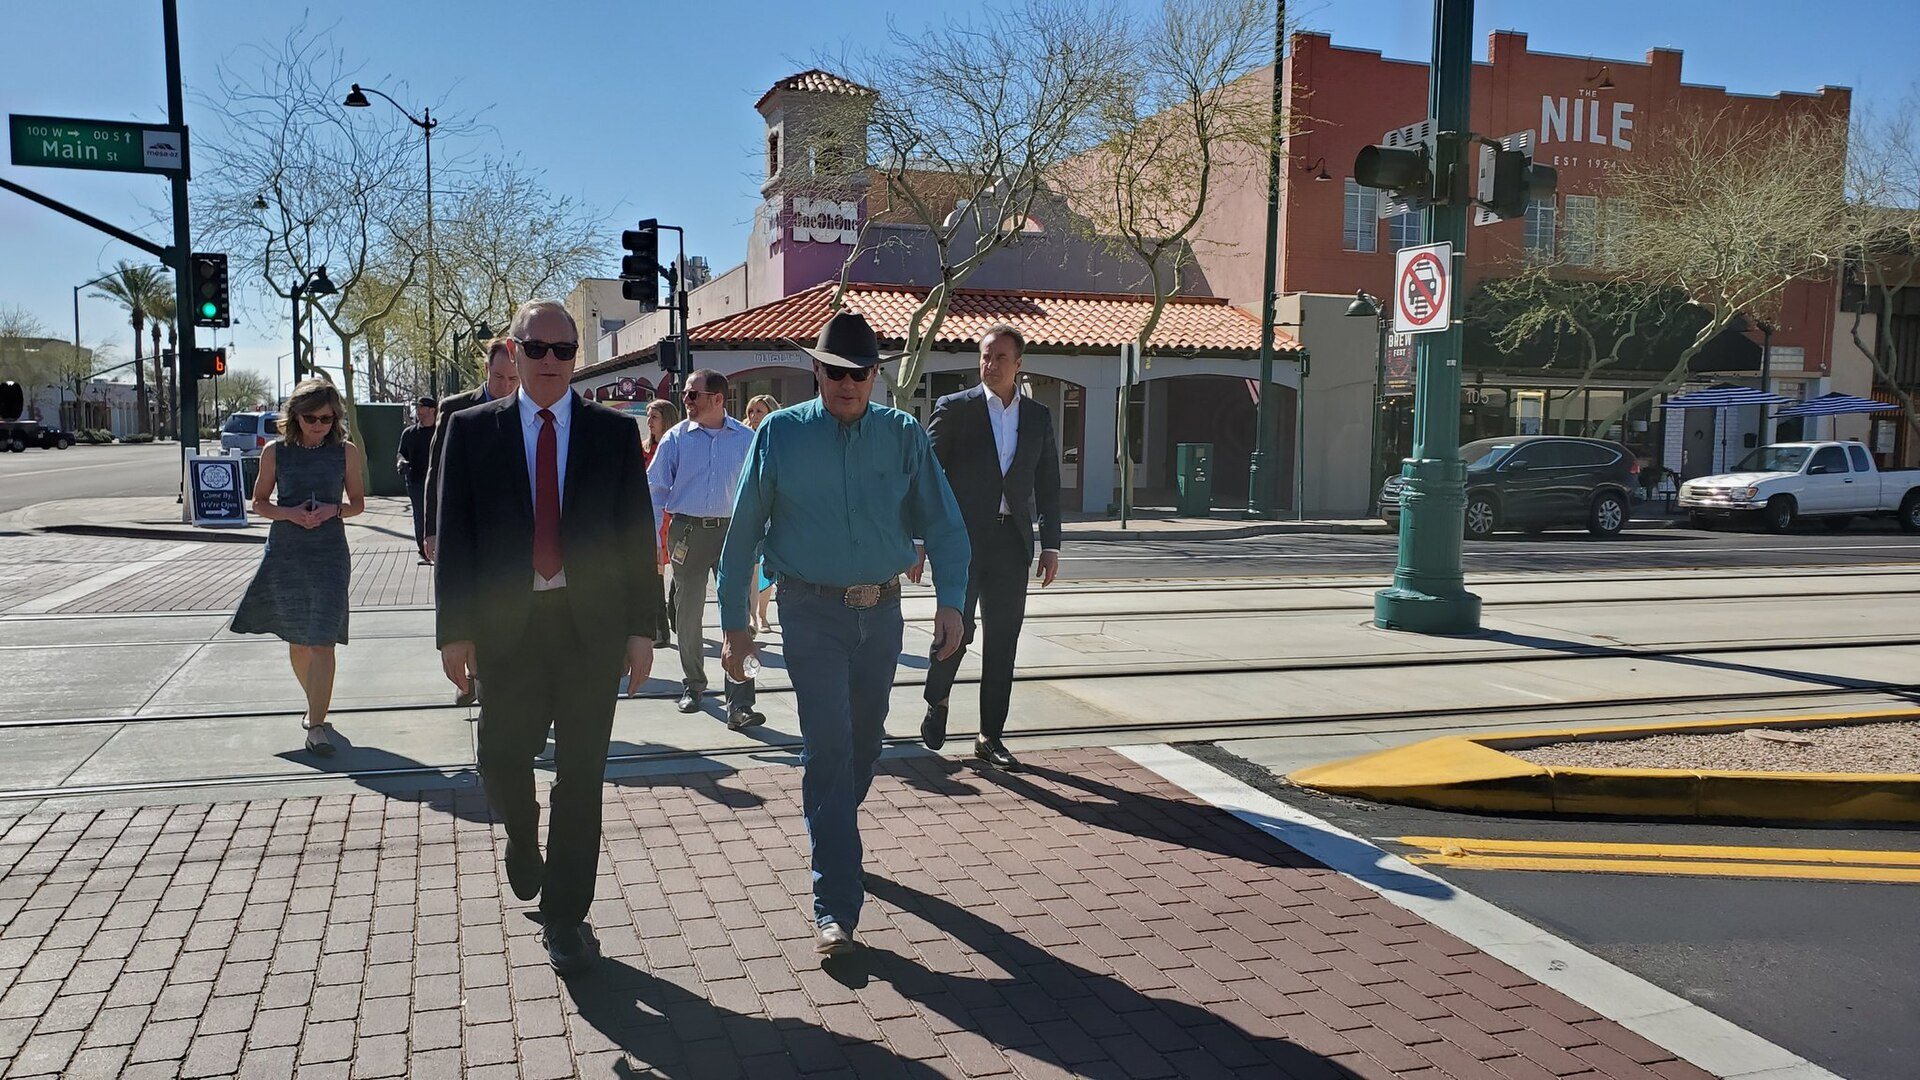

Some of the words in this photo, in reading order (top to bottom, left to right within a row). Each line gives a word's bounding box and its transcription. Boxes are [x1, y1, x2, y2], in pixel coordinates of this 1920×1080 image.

[1579, 89, 1598, 98] THE
[1540, 95, 1634, 151] NILE
[27, 126, 47, 137] 100
[52, 127, 63, 138] W
[93, 130, 109, 141] 00
[113, 131, 120, 142] S
[42, 139, 99, 161] Main
[106, 151, 118, 162] St
[1553, 155, 1578, 166] EST
[1388, 334, 1412, 348] BREW
